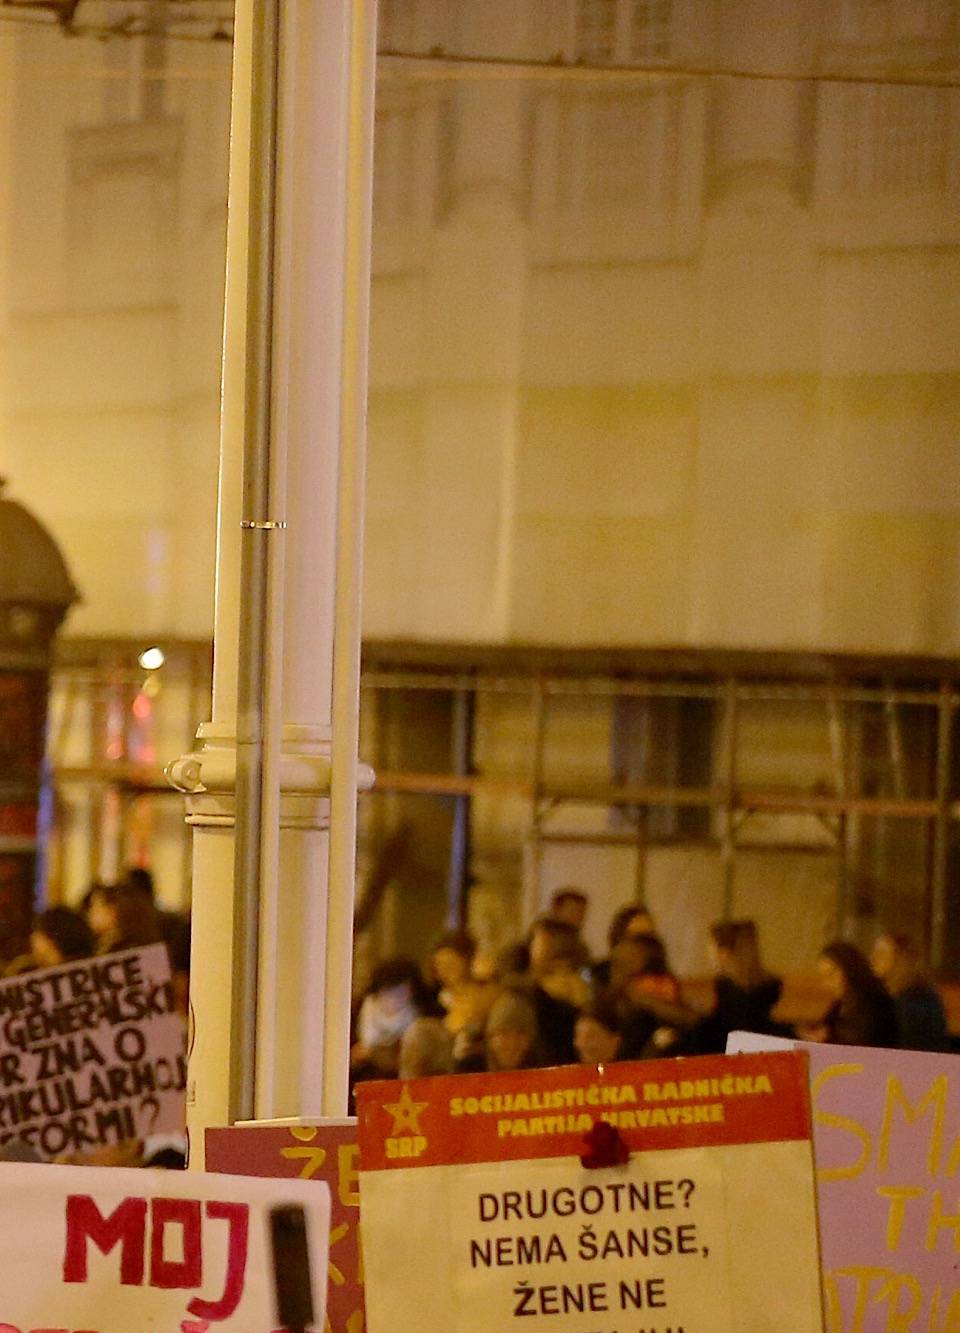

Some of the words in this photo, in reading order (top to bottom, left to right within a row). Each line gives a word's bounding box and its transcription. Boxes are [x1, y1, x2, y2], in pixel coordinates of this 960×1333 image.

[3, 982, 176, 1052] GENERALSKI
[30, 1037, 106, 1081] ZNA
[113, 1027, 147, 1062] O
[450, 1083, 638, 1117] SOCIJALISTIČKA
[642, 1073, 774, 1101] RADNIČKA
[497, 1113, 593, 1138] PARTIJA
[601, 1102, 726, 1130] HRVATSKE
[384, 1135, 428, 1158] SRP
[478, 1178, 696, 1222] DRUGOTNE?
[63, 1195, 249, 1321] MOJ
[470, 1234, 567, 1268] NEMA
[577, 1224, 710, 1262] ŠANSE,
[513, 1281, 609, 1318] ŽENE
[619, 1278, 668, 1311] NE
